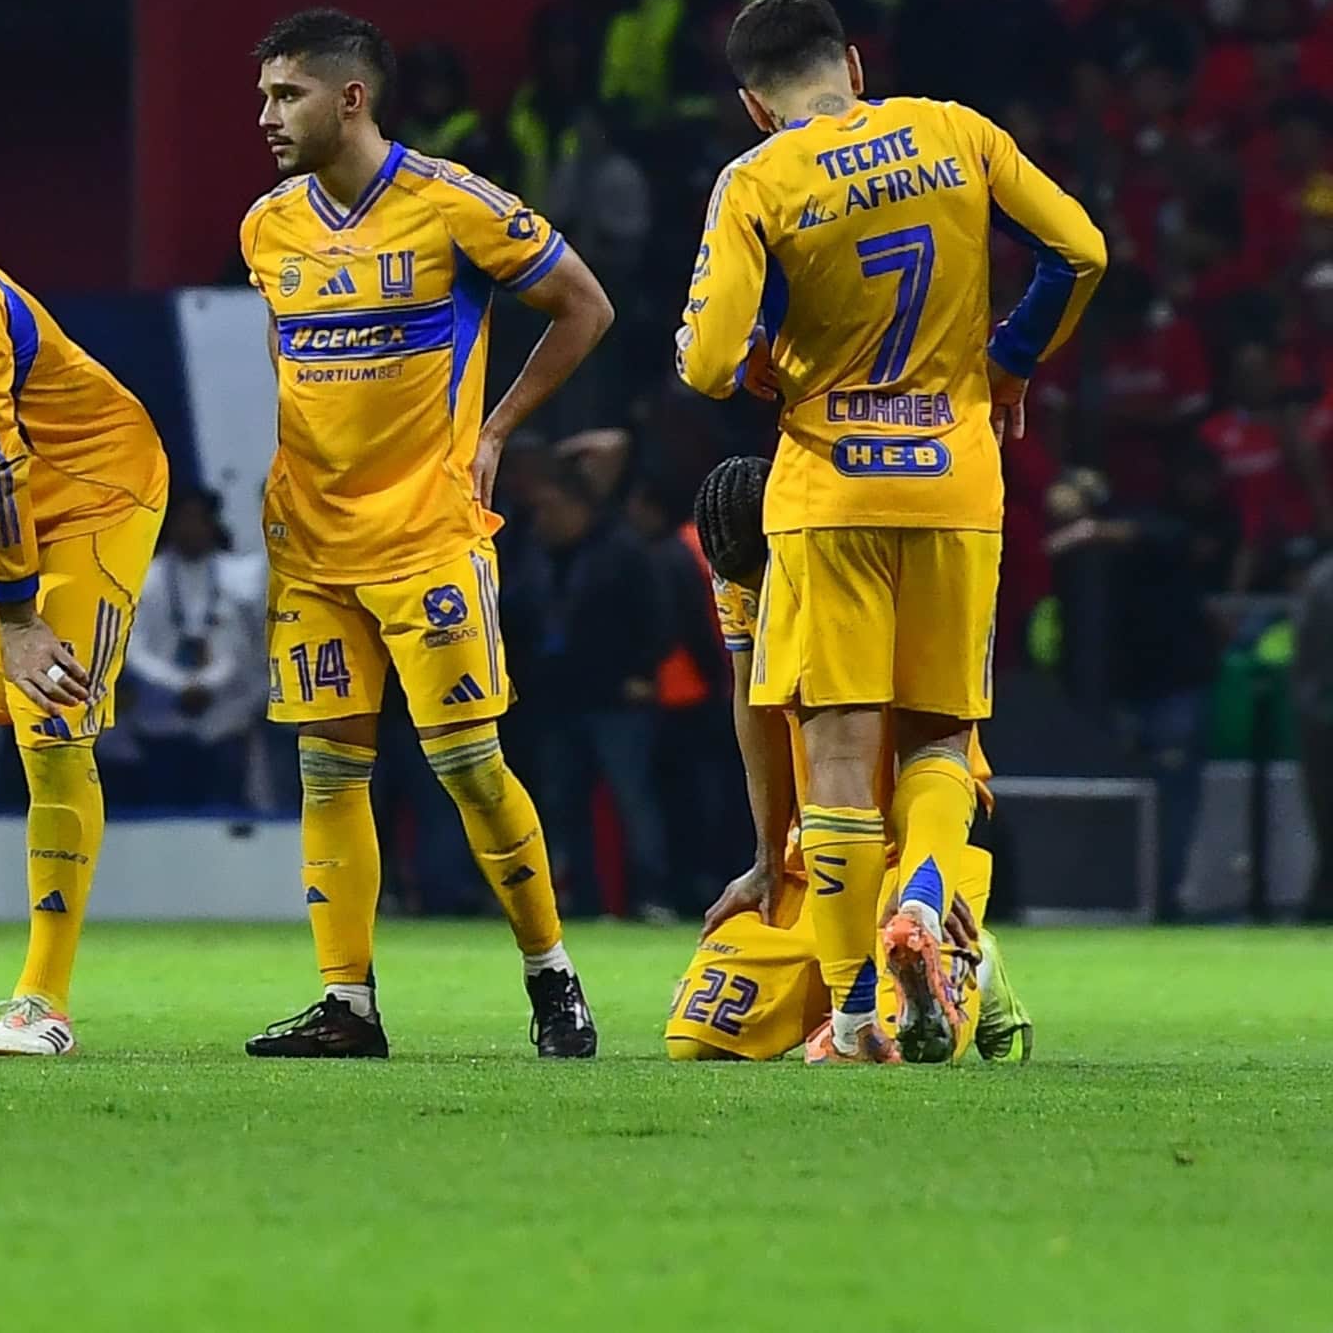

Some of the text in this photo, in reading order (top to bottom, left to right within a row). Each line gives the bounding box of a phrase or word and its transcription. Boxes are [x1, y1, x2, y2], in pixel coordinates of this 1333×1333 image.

[816, 126, 920, 181] TECATE
[845, 157, 967, 216] AFIRME
[855, 224, 936, 385] 7
[311, 326, 405, 350] CEMEX
[826, 390, 955, 428] CORREA
[289, 638, 351, 703] 14
[684, 967, 760, 1037] 22
